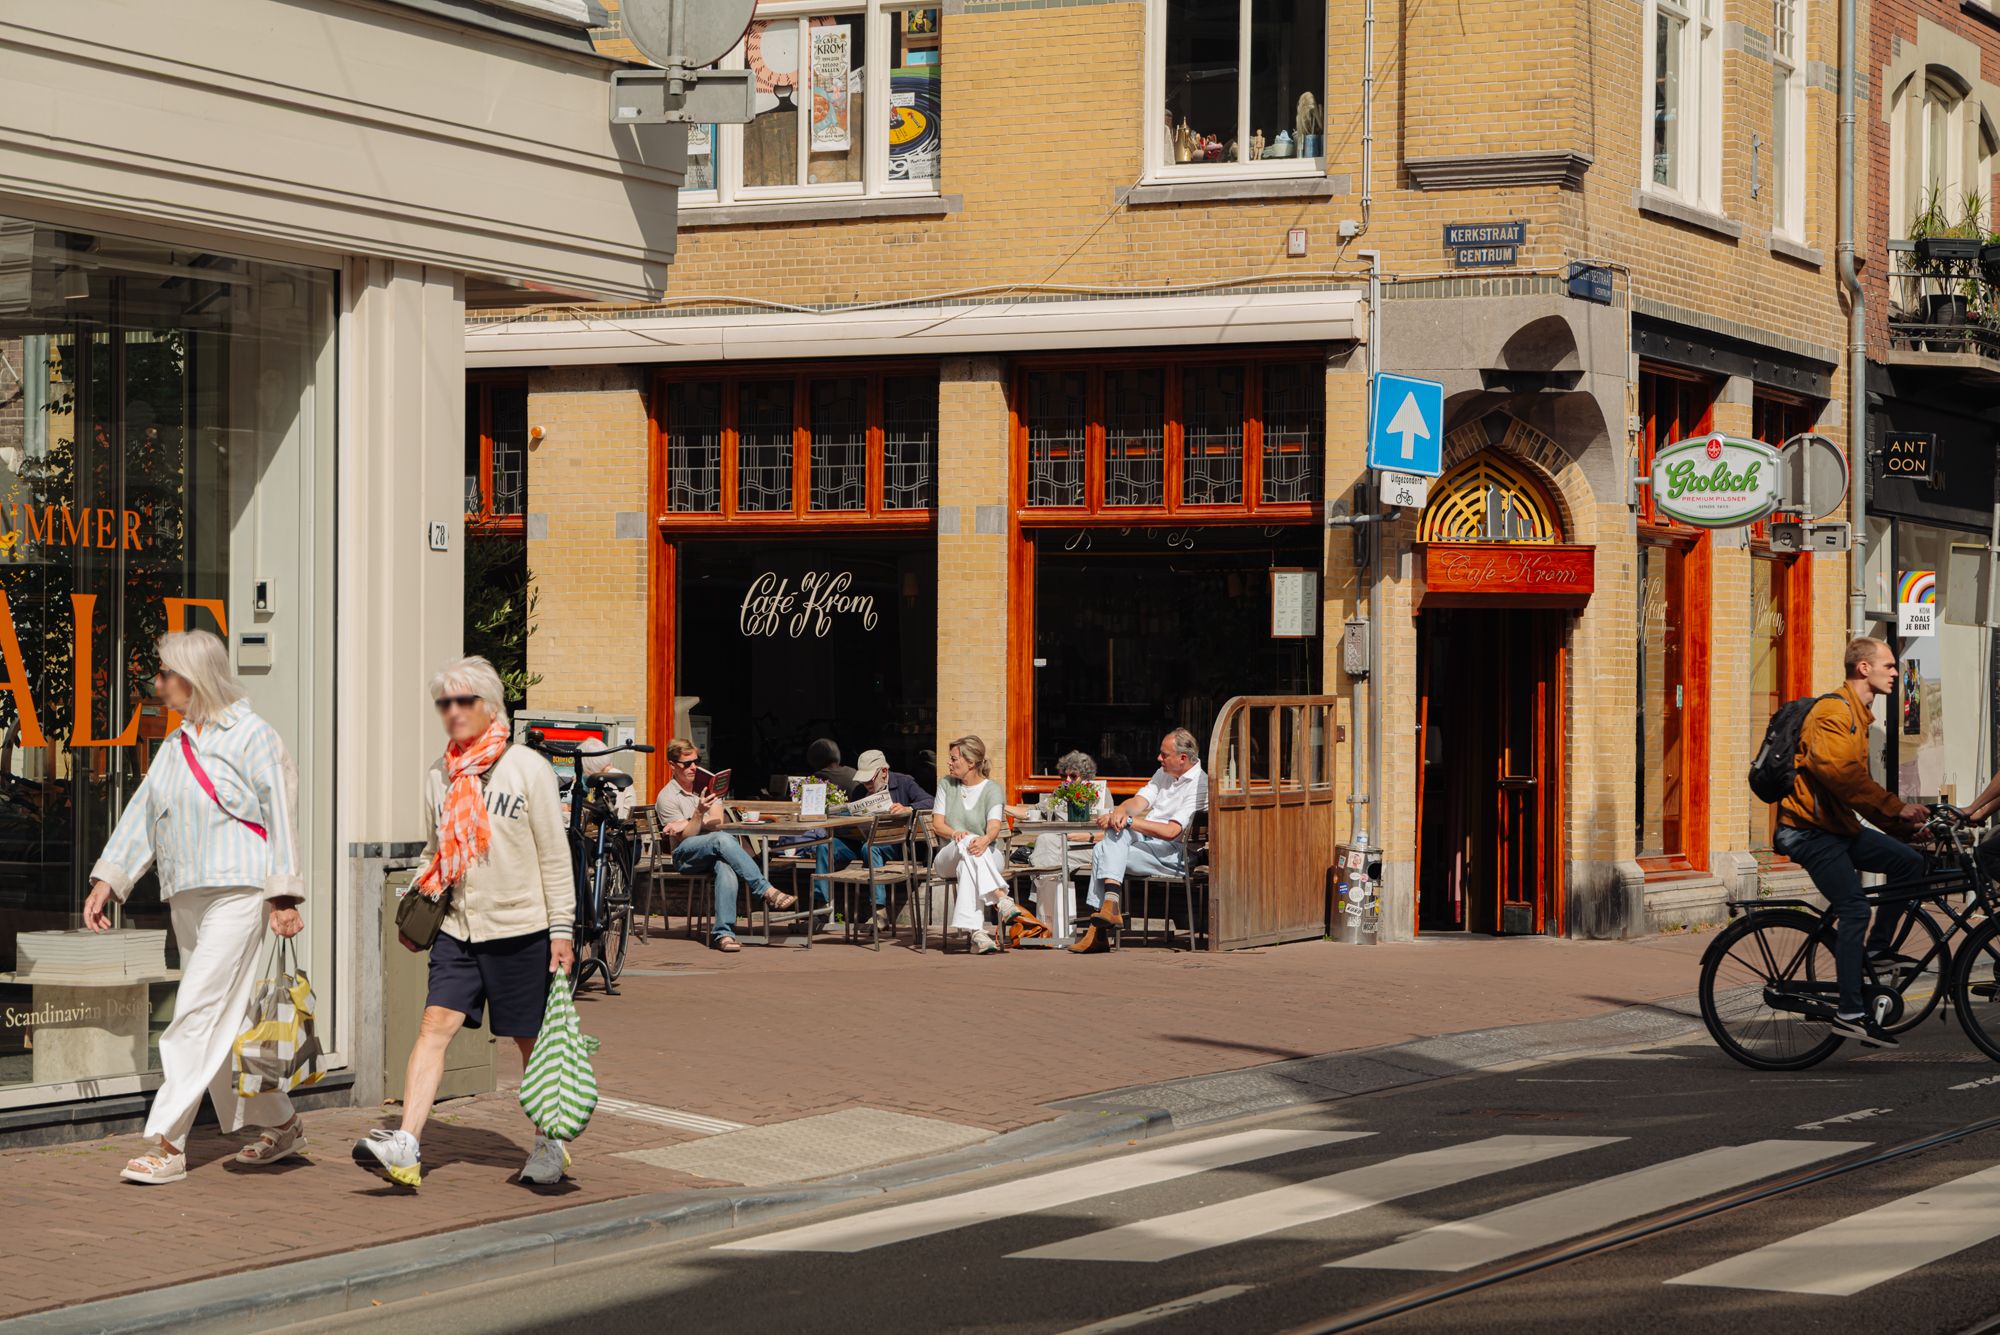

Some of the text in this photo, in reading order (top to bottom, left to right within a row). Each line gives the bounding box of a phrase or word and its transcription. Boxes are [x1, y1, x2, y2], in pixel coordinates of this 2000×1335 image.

[817, 43, 844, 55] KROM
[1451, 227, 1519, 243] KERKSTRAAT
[1460, 248, 1512, 263] CENTRUM
[1890, 440, 1927, 454] ANT
[1888, 457, 1926, 472] OON
[1665, 460, 1761, 499] Grolsch
[435, 525, 446, 546] 78
[740, 571, 878, 638] Café Krom
[1910, 615, 1931, 623] ZOALS
[1905, 623, 1931, 631] JE BENT
[5, 1002, 101, 1028] Scandinavian
